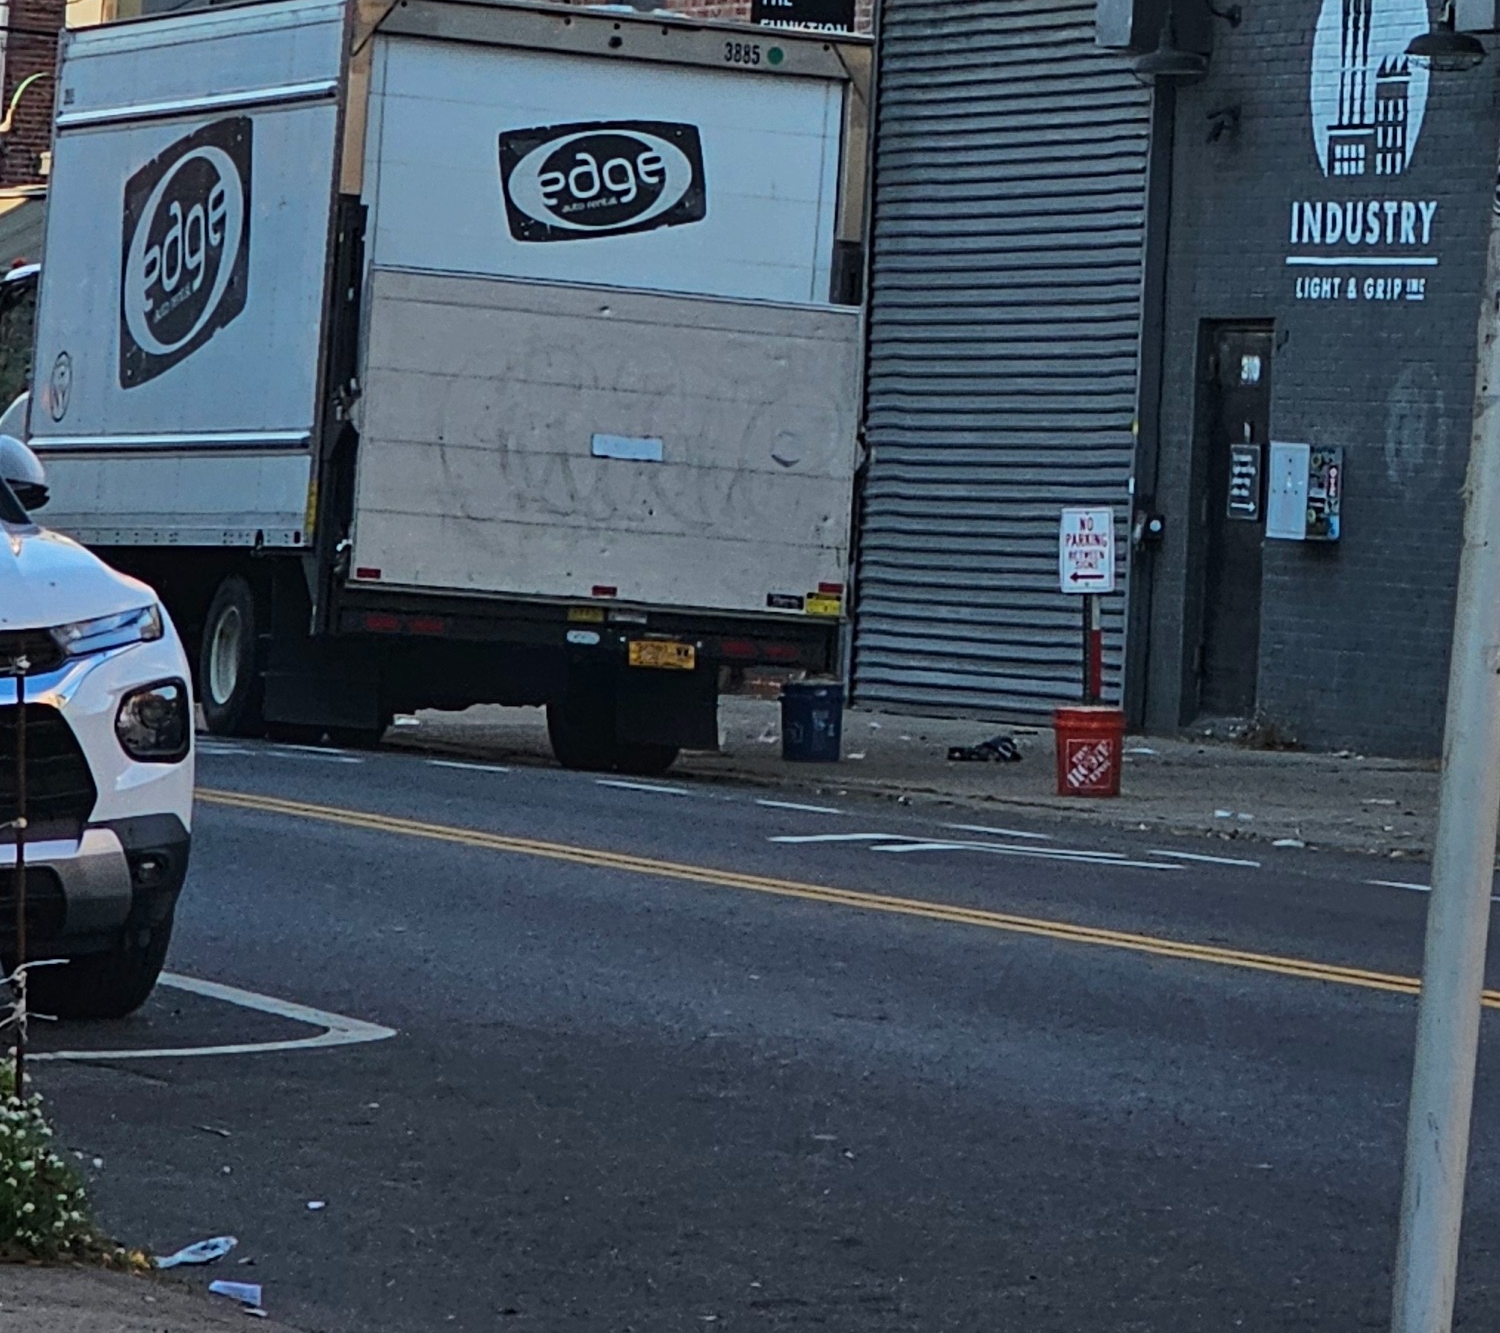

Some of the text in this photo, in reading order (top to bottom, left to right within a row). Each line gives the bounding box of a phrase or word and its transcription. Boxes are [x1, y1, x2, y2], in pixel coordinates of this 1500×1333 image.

[724, 41, 761, 65] 3885
[539, 151, 665, 206] edge
[1290, 200, 1438, 244] INDUSTRY
[143, 183, 227, 313] edge
[1295, 276, 1341, 299] LIGHT
[1346, 276, 1357, 299] &
[1363, 276, 1402, 301] GRIP
[1079, 517, 1094, 531] NO
[1065, 533, 1108, 547] PARKING
